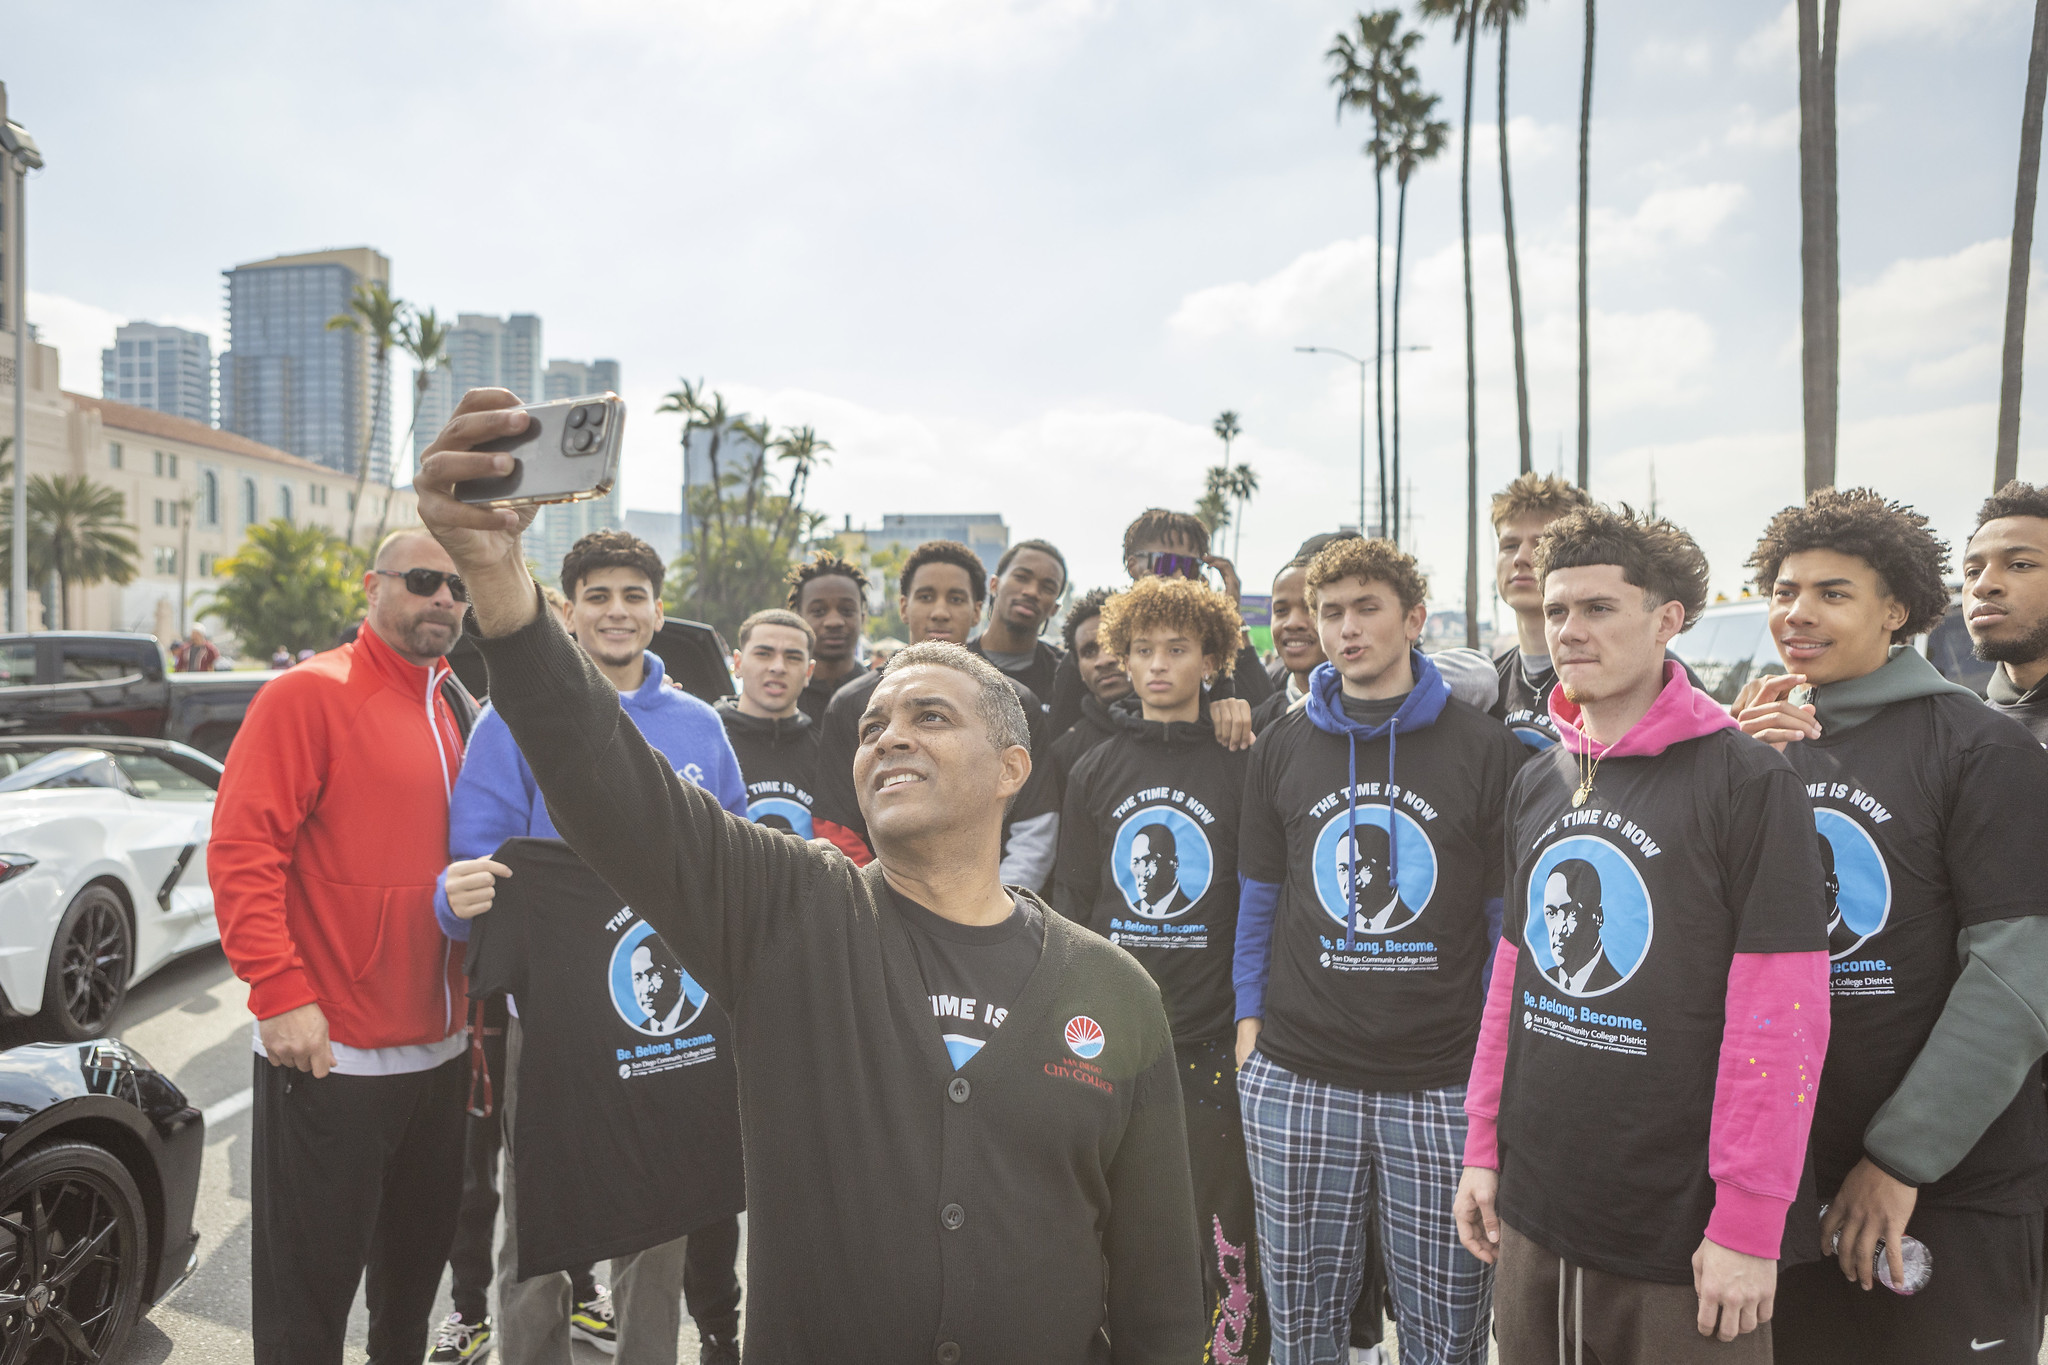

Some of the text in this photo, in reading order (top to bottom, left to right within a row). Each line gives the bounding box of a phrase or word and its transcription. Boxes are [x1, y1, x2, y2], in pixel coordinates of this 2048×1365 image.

[1534, 714, 1550, 726] IS
[748, 781, 813, 806] TIME IS NO
[1112, 786, 1216, 825] THE TIME IS NOW
[1309, 783, 1438, 822] THE TME IS NOW
[1806, 782, 1892, 824] ME IS NOW
[1562, 810, 1601, 828] TIME
[1603, 812, 1621, 829] IS
[1621, 820, 1661, 858] NOW
[604, 905, 634, 932] THE
[1110, 918, 1208, 935] Be. Belong. Become.
[1336, 938, 1383, 955] Bong.
[1385, 940, 1438, 952] Become.
[1344, 956, 1361, 964] Diego
[1362, 956, 1396, 964] Community
[1396, 956, 1418, 964] College
[1835, 978, 1863, 988] College
[1864, 977, 1893, 986] District
[928, 994, 1009, 1028] IME IS
[1524, 991, 1647, 1032] Be. Belong. Become.
[1534, 1014, 1542, 1024] San
[1543, 1017, 1558, 1029] Diego
[1559, 1021, 1590, 1038] Community
[1591, 1030, 1618, 1043] College
[1620, 1034, 1647, 1046] District
[616, 1033, 716, 1061] Be. Belong. Become.
[642, 1060, 657, 1068] Diego
[656, 1054, 682, 1064] Community
[1079, 1061, 1102, 1074] DIEGO
[1044, 1062, 1113, 1094] CITY COLLEGE
